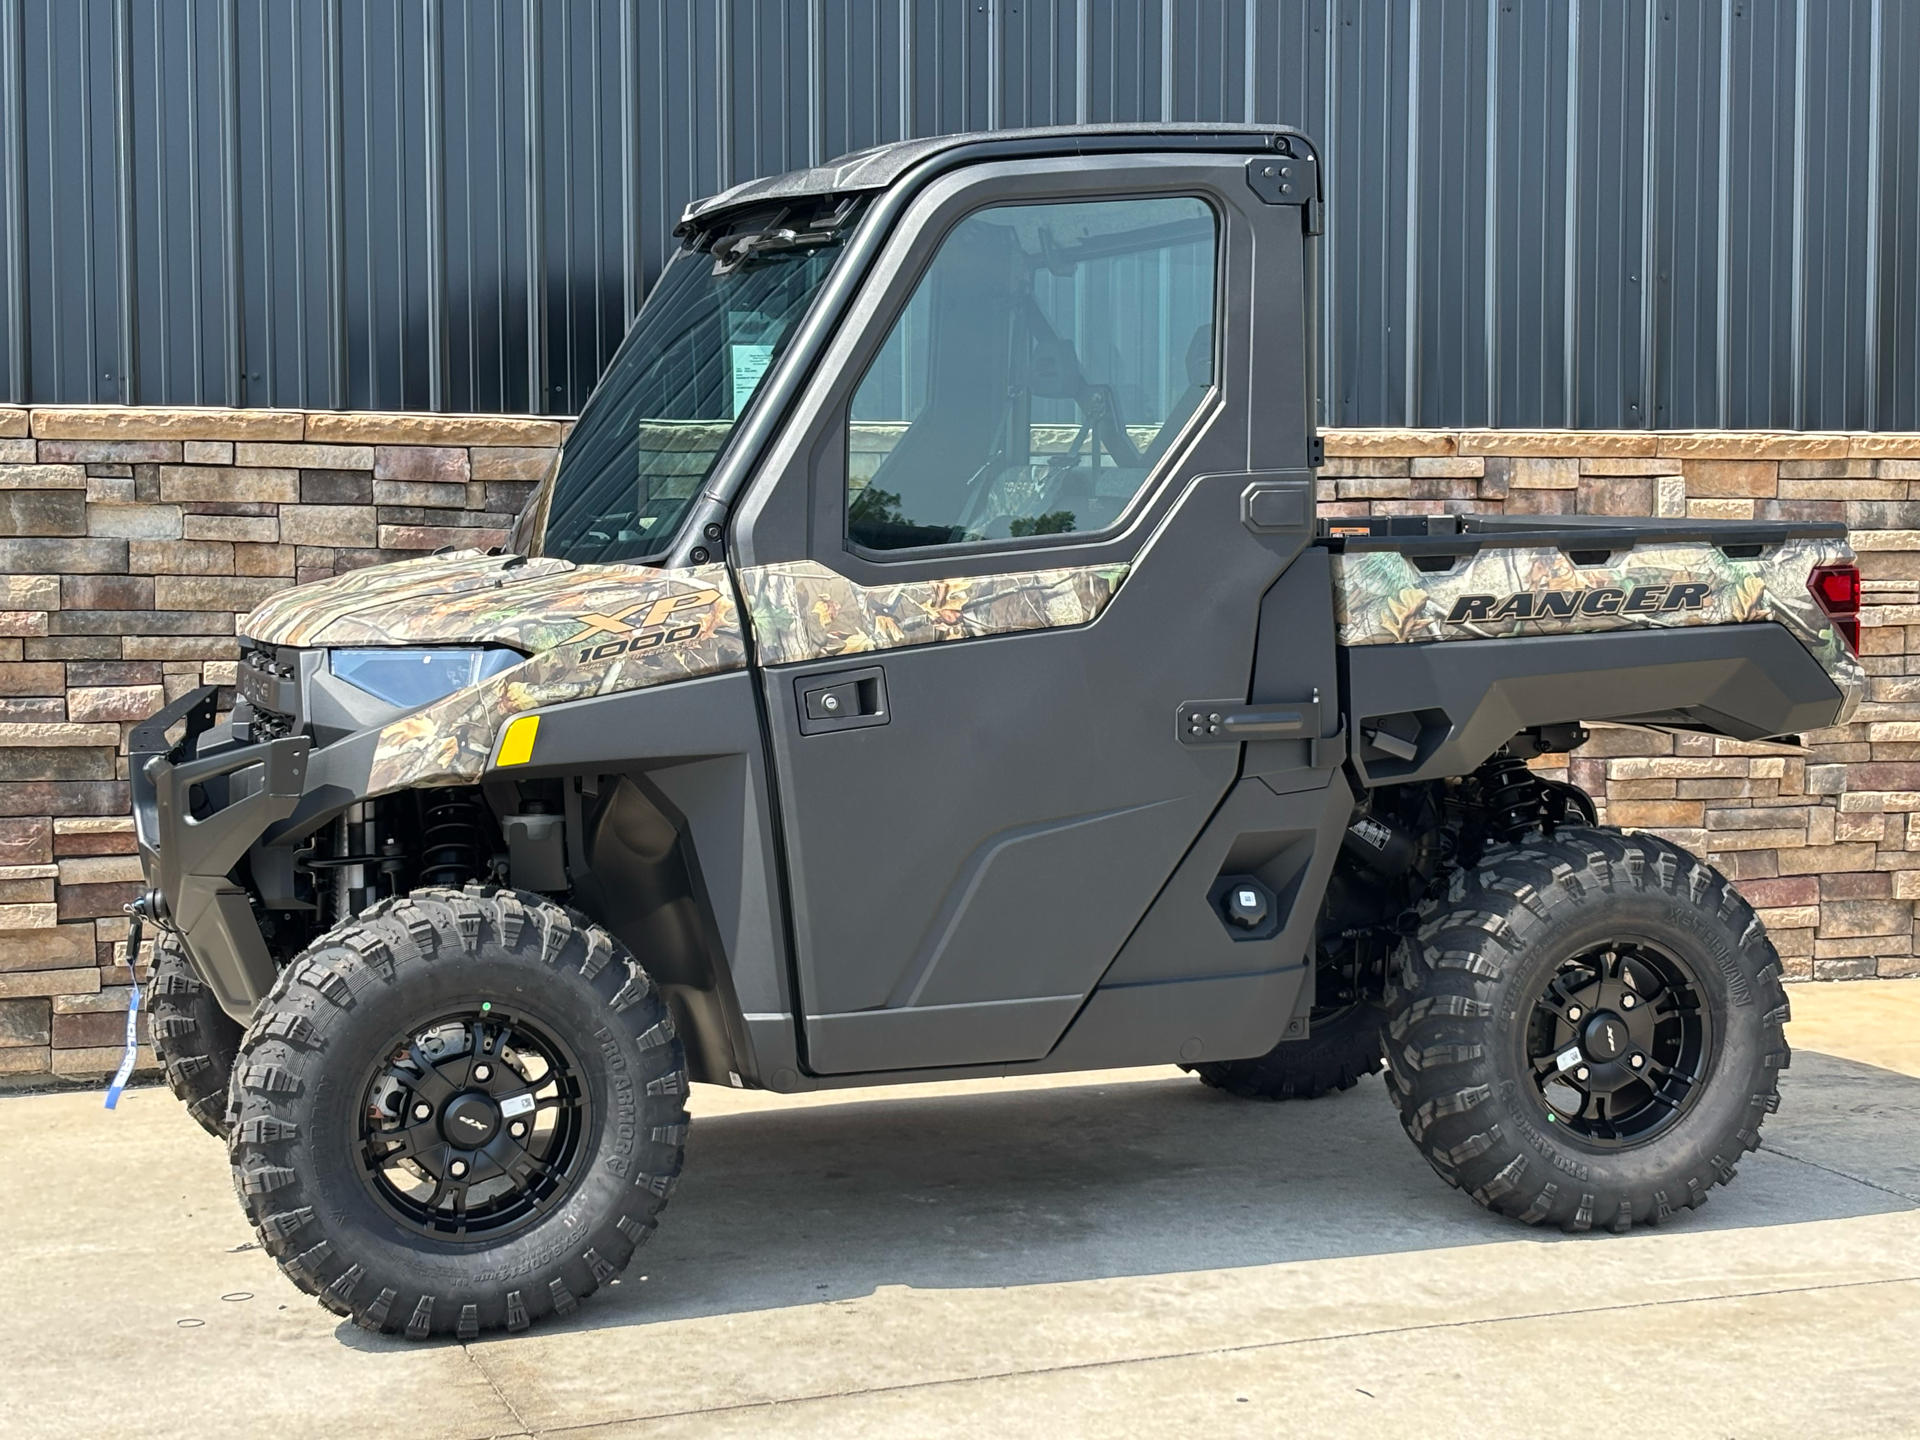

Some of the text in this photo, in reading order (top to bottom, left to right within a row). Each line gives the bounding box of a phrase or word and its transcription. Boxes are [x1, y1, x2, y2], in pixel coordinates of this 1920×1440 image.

[550, 588, 723, 649] XP
[1445, 581, 1712, 625] RANGER
[577, 622, 702, 666] 1000
[577, 662, 605, 672] DUAL
[1666, 906, 1752, 1007] X-TERRAIN
[112, 1009, 138, 1087] POLARIS
[594, 1026, 635, 1154] PRO ARMOR
[459, 1116, 488, 1131] XP
[1553, 1154, 1588, 1181] PRO
